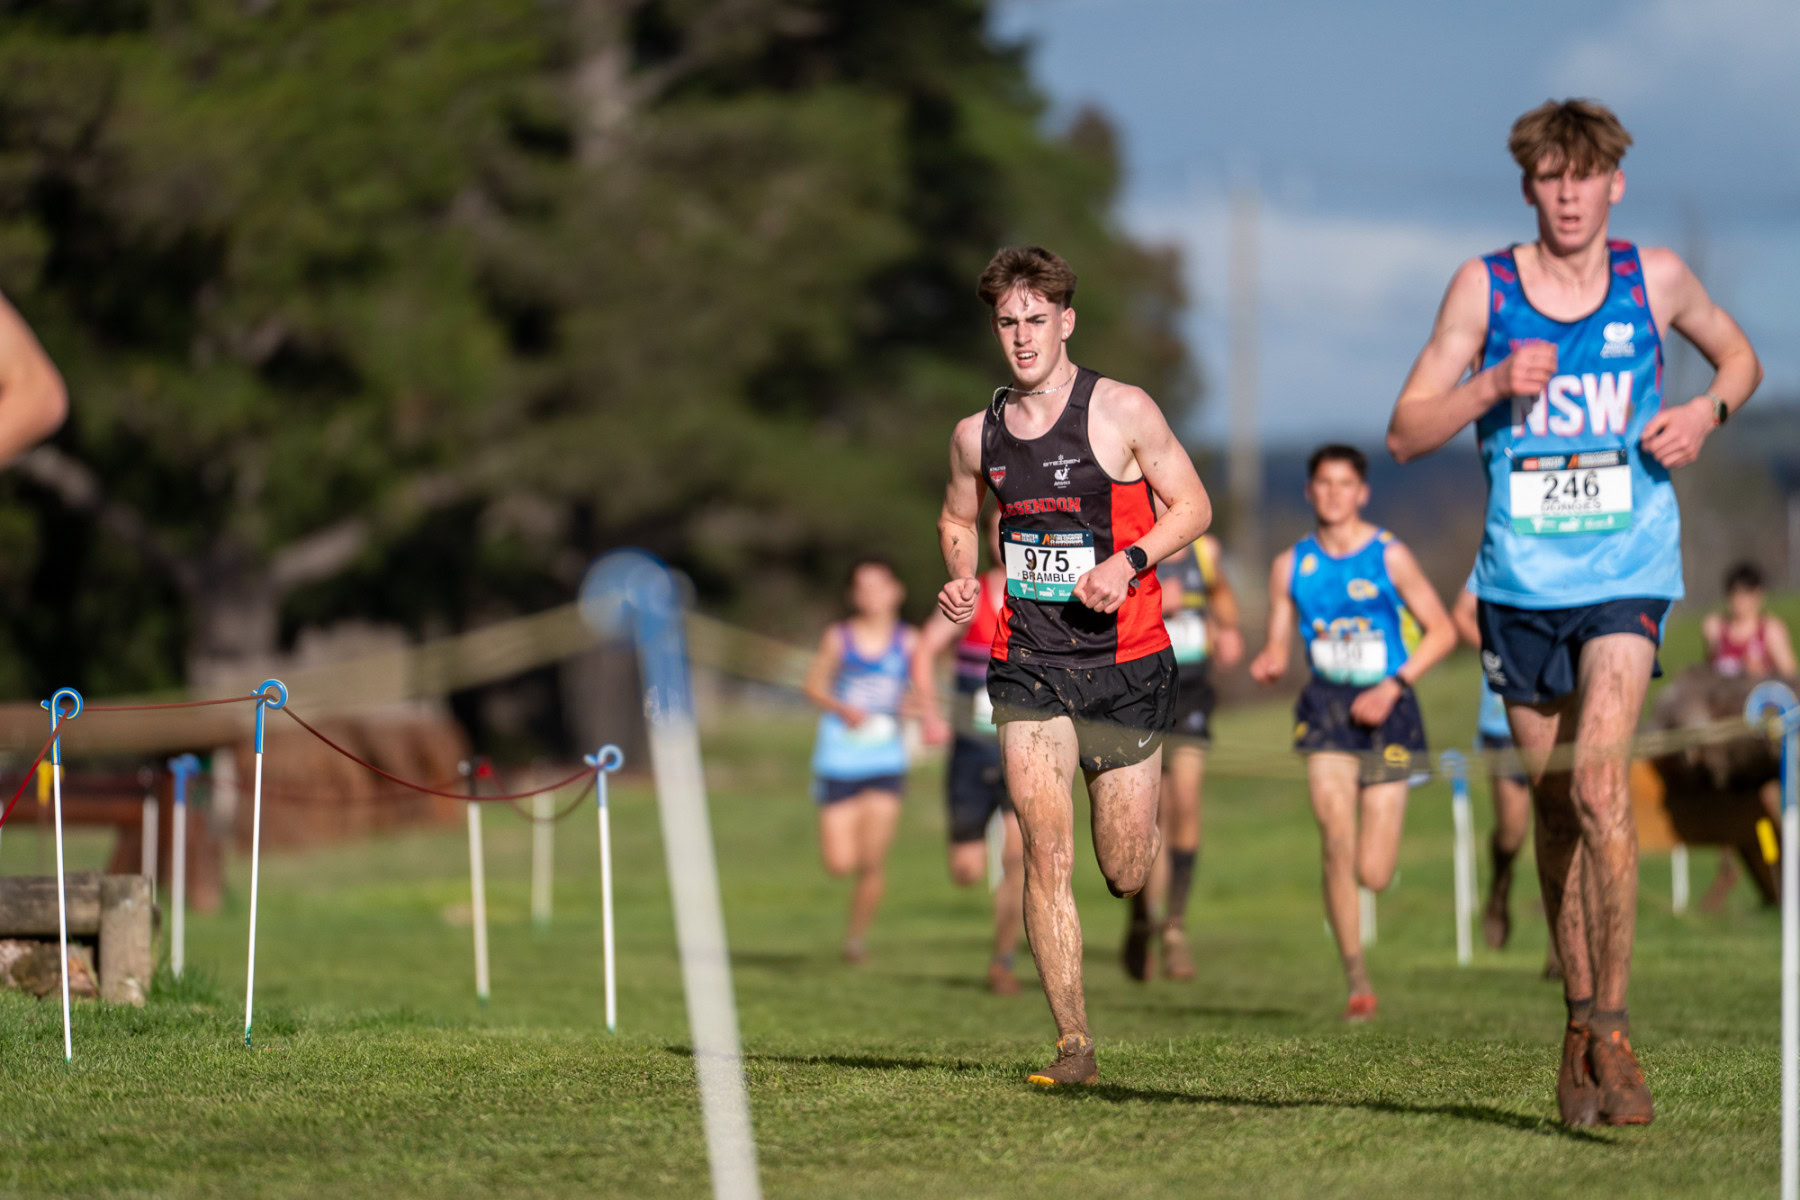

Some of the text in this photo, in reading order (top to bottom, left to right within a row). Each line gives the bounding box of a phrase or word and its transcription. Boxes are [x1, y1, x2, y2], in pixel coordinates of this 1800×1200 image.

[1511, 371, 1632, 437] NSW
[1543, 469, 1600, 500] 246
[1024, 548, 1069, 572] 975
[1022, 570, 1076, 583] BRAMBLE
